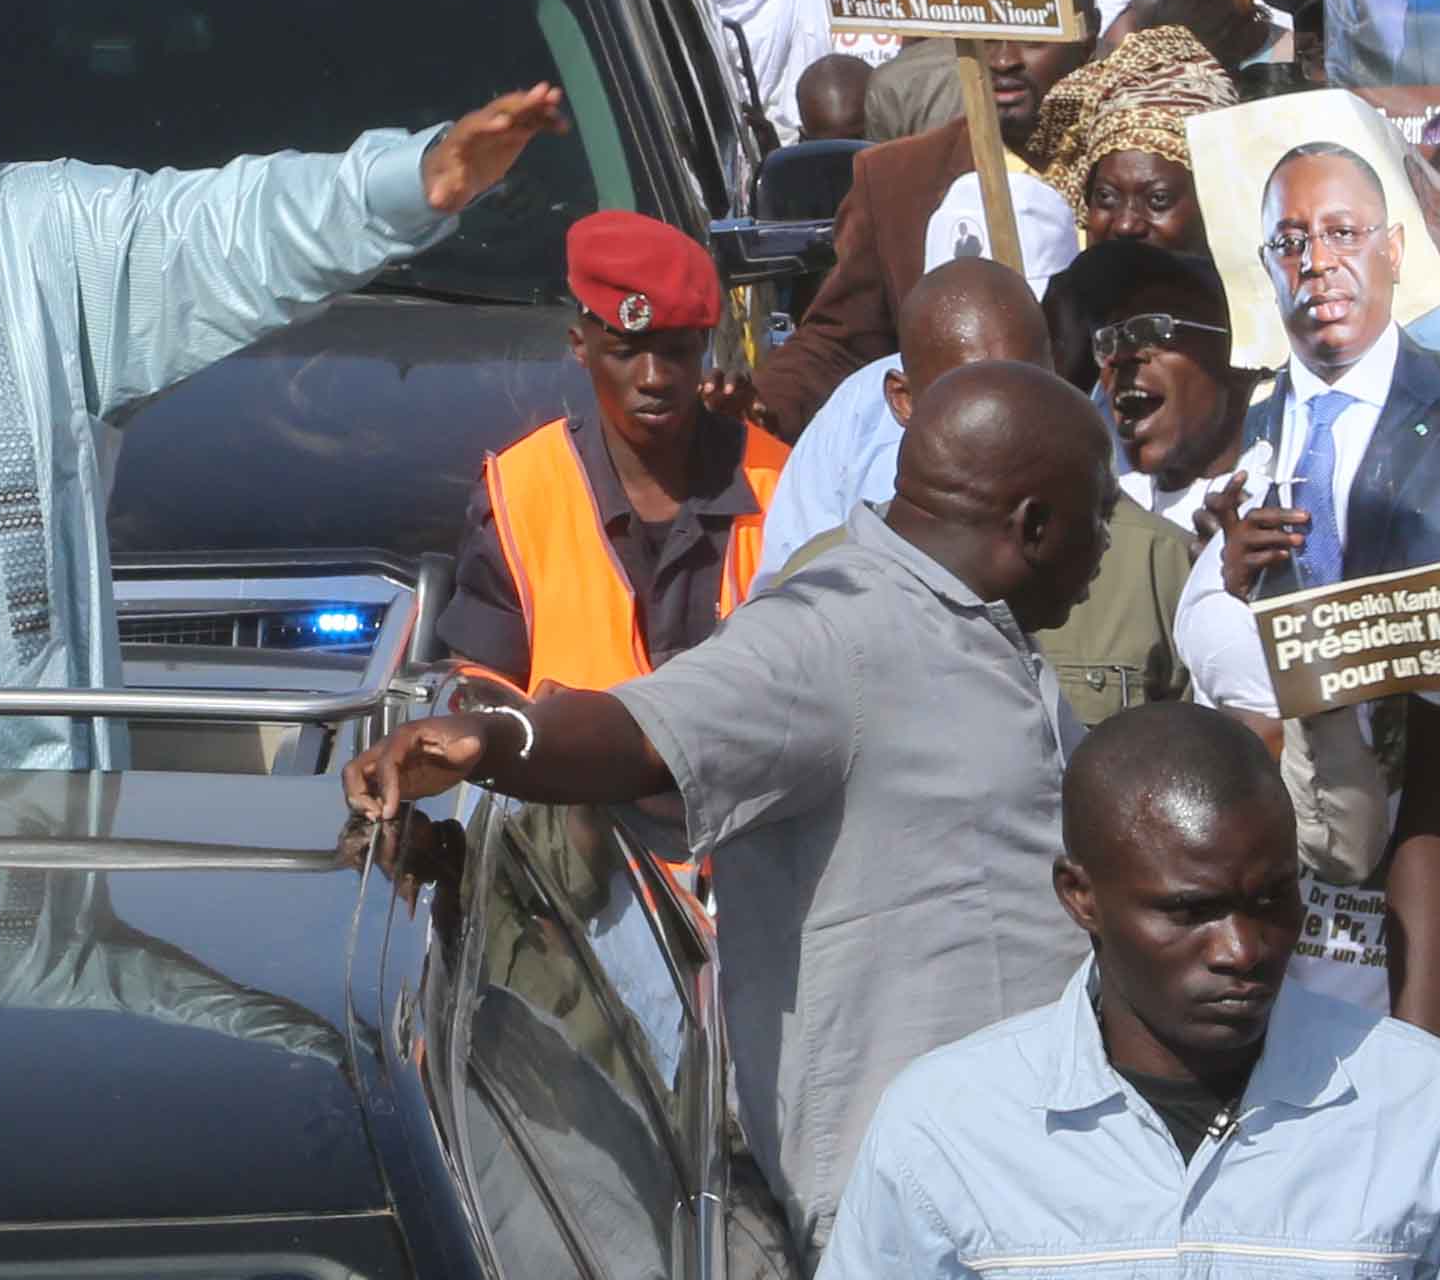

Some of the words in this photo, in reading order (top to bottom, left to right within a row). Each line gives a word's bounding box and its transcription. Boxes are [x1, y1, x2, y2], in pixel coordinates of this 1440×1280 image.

[1272, 611, 1308, 639] Dr
[1312, 592, 1394, 628] Cheikh
[1275, 620, 1426, 671] Président
[1320, 657, 1390, 702] pour
[1393, 654, 1419, 679] un
[1309, 886, 1329, 906] Dr
[1333, 948, 1356, 964] un
